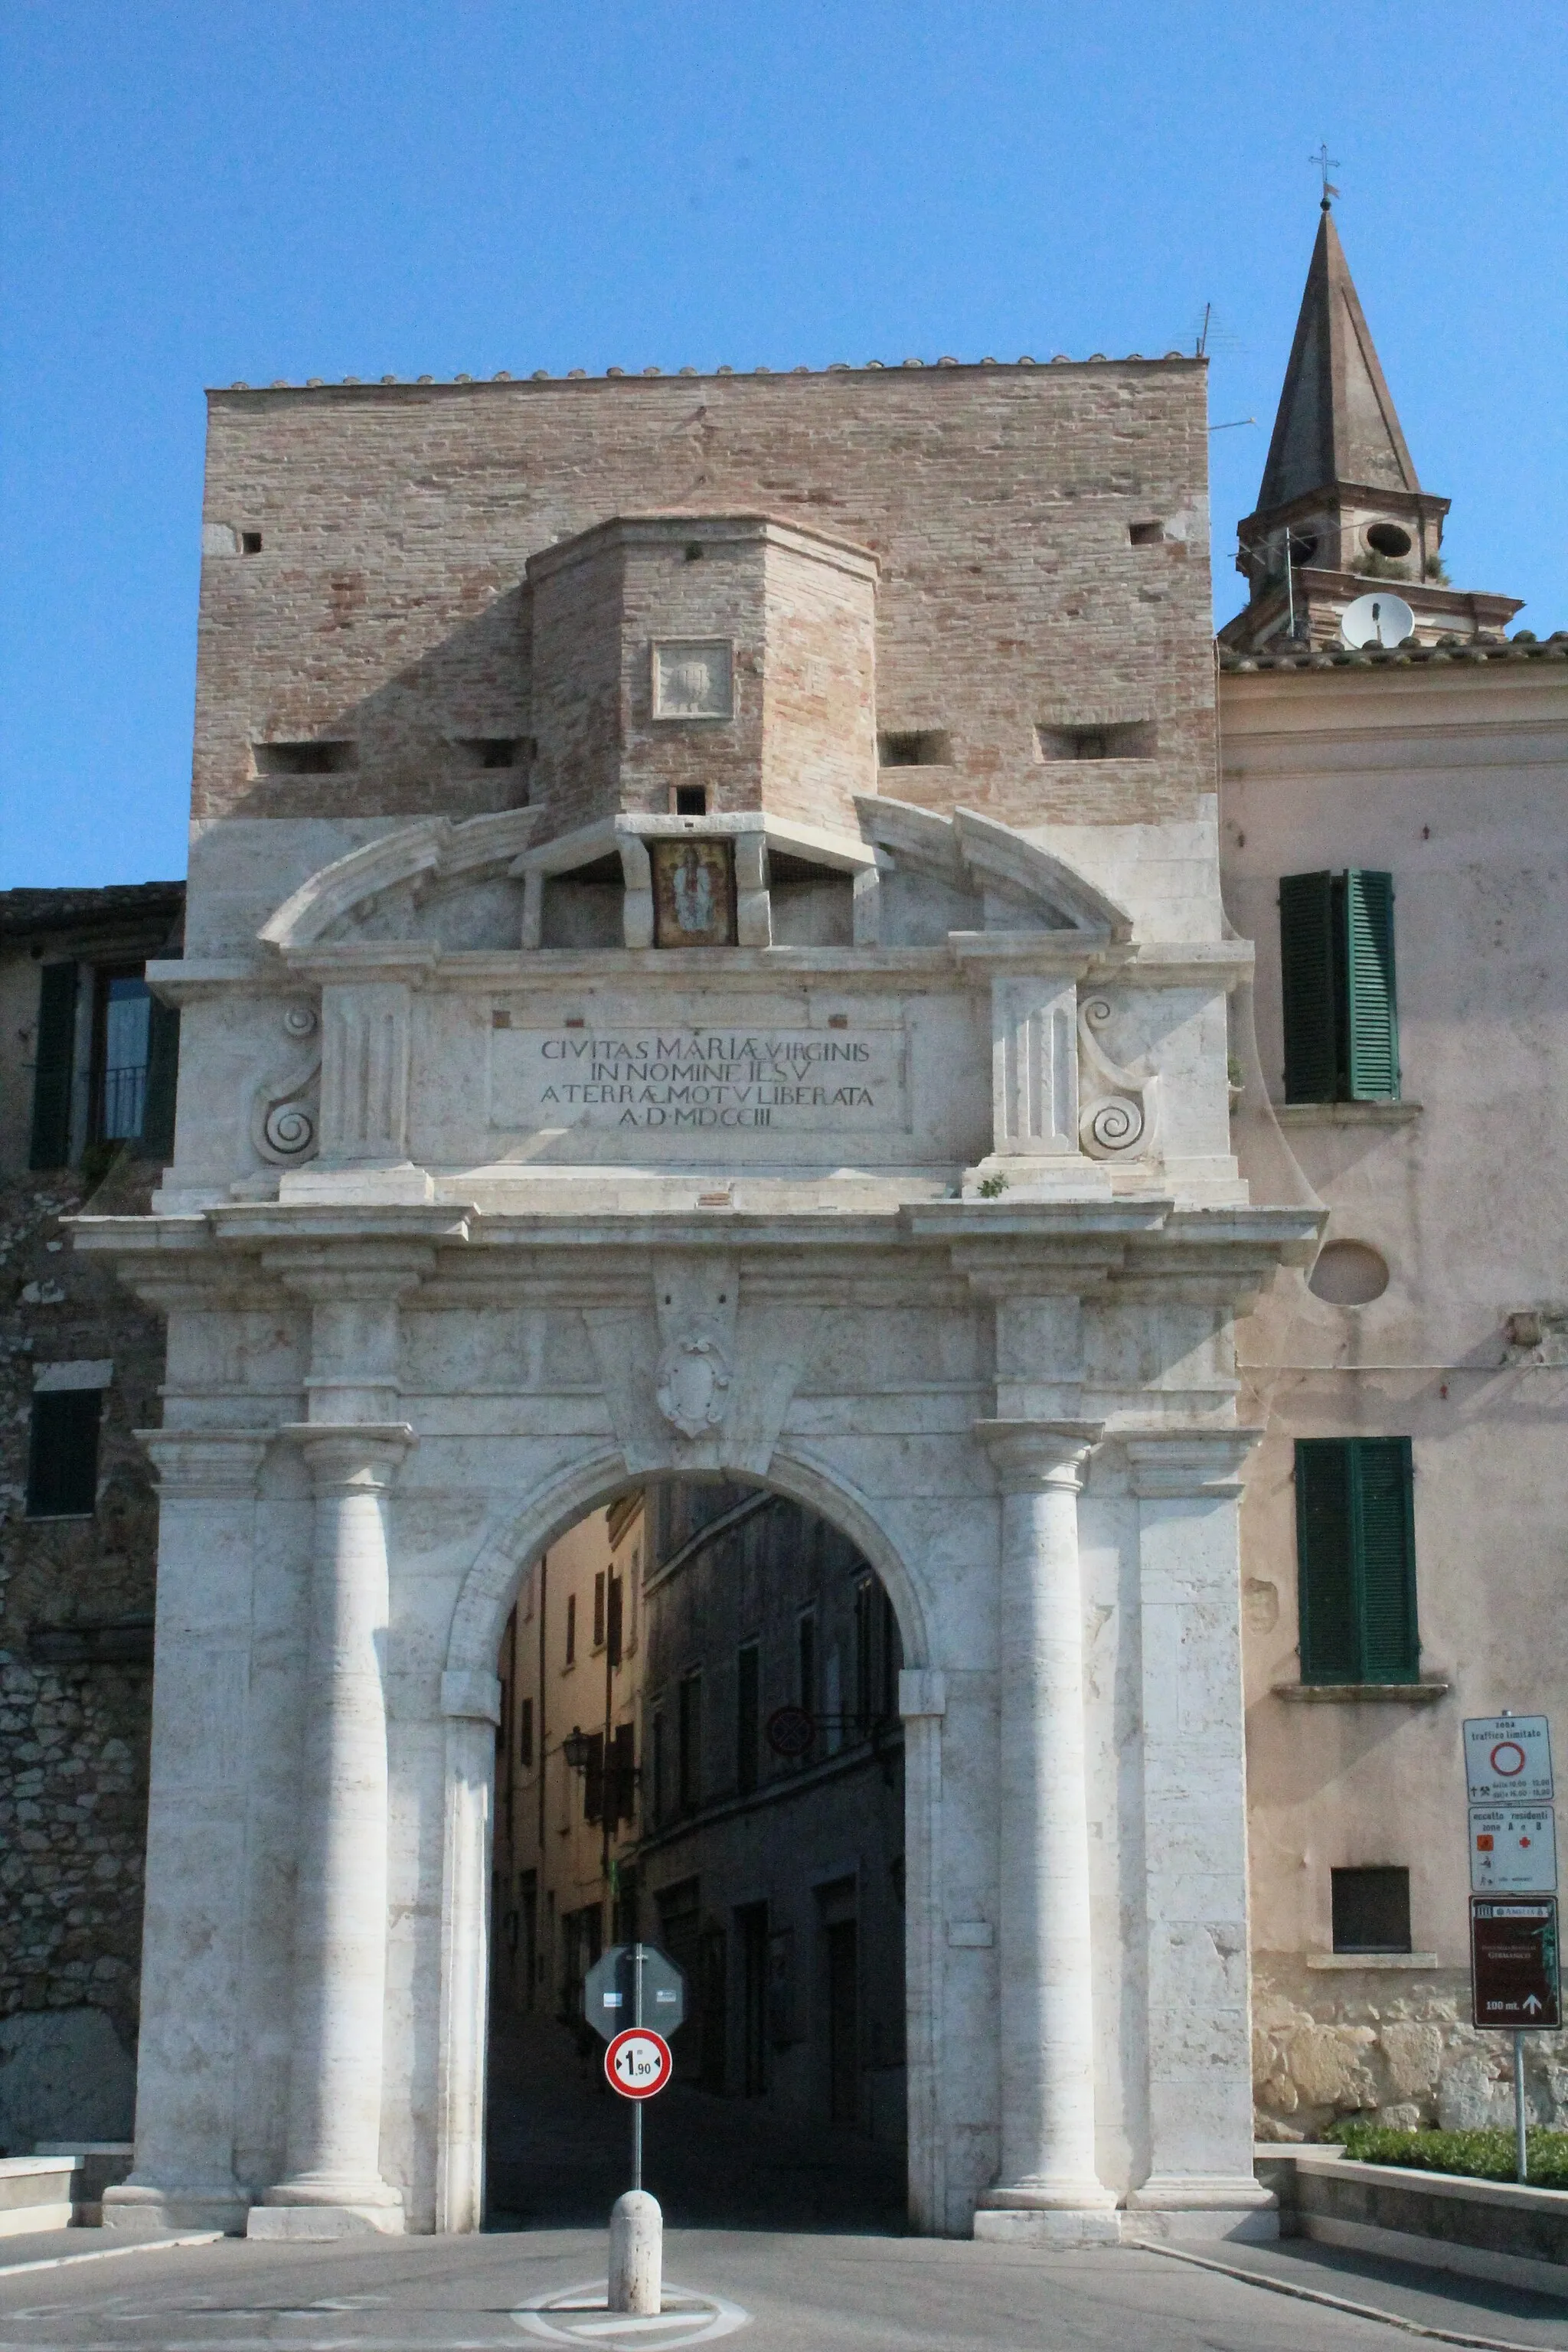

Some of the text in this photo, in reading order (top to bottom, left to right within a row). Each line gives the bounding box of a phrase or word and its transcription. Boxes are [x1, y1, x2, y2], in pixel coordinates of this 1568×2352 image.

[541, 1040, 648, 1060] CIVITAS
[765, 1042, 870, 1061] VIRGINIS
[591, 1062, 619, 1081] IN
[626, 1062, 741, 1082] NOMINE
[757, 1086, 874, 1106] LIBERATA
[1472, 1729, 1541, 1740] traffico limitato
[1473, 1810, 1548, 1820] eccetto residenti
[1508, 1821, 1514, 1831] A
[1536, 1821, 1542, 1831] B
[1486, 2001, 1503, 2011] 100
